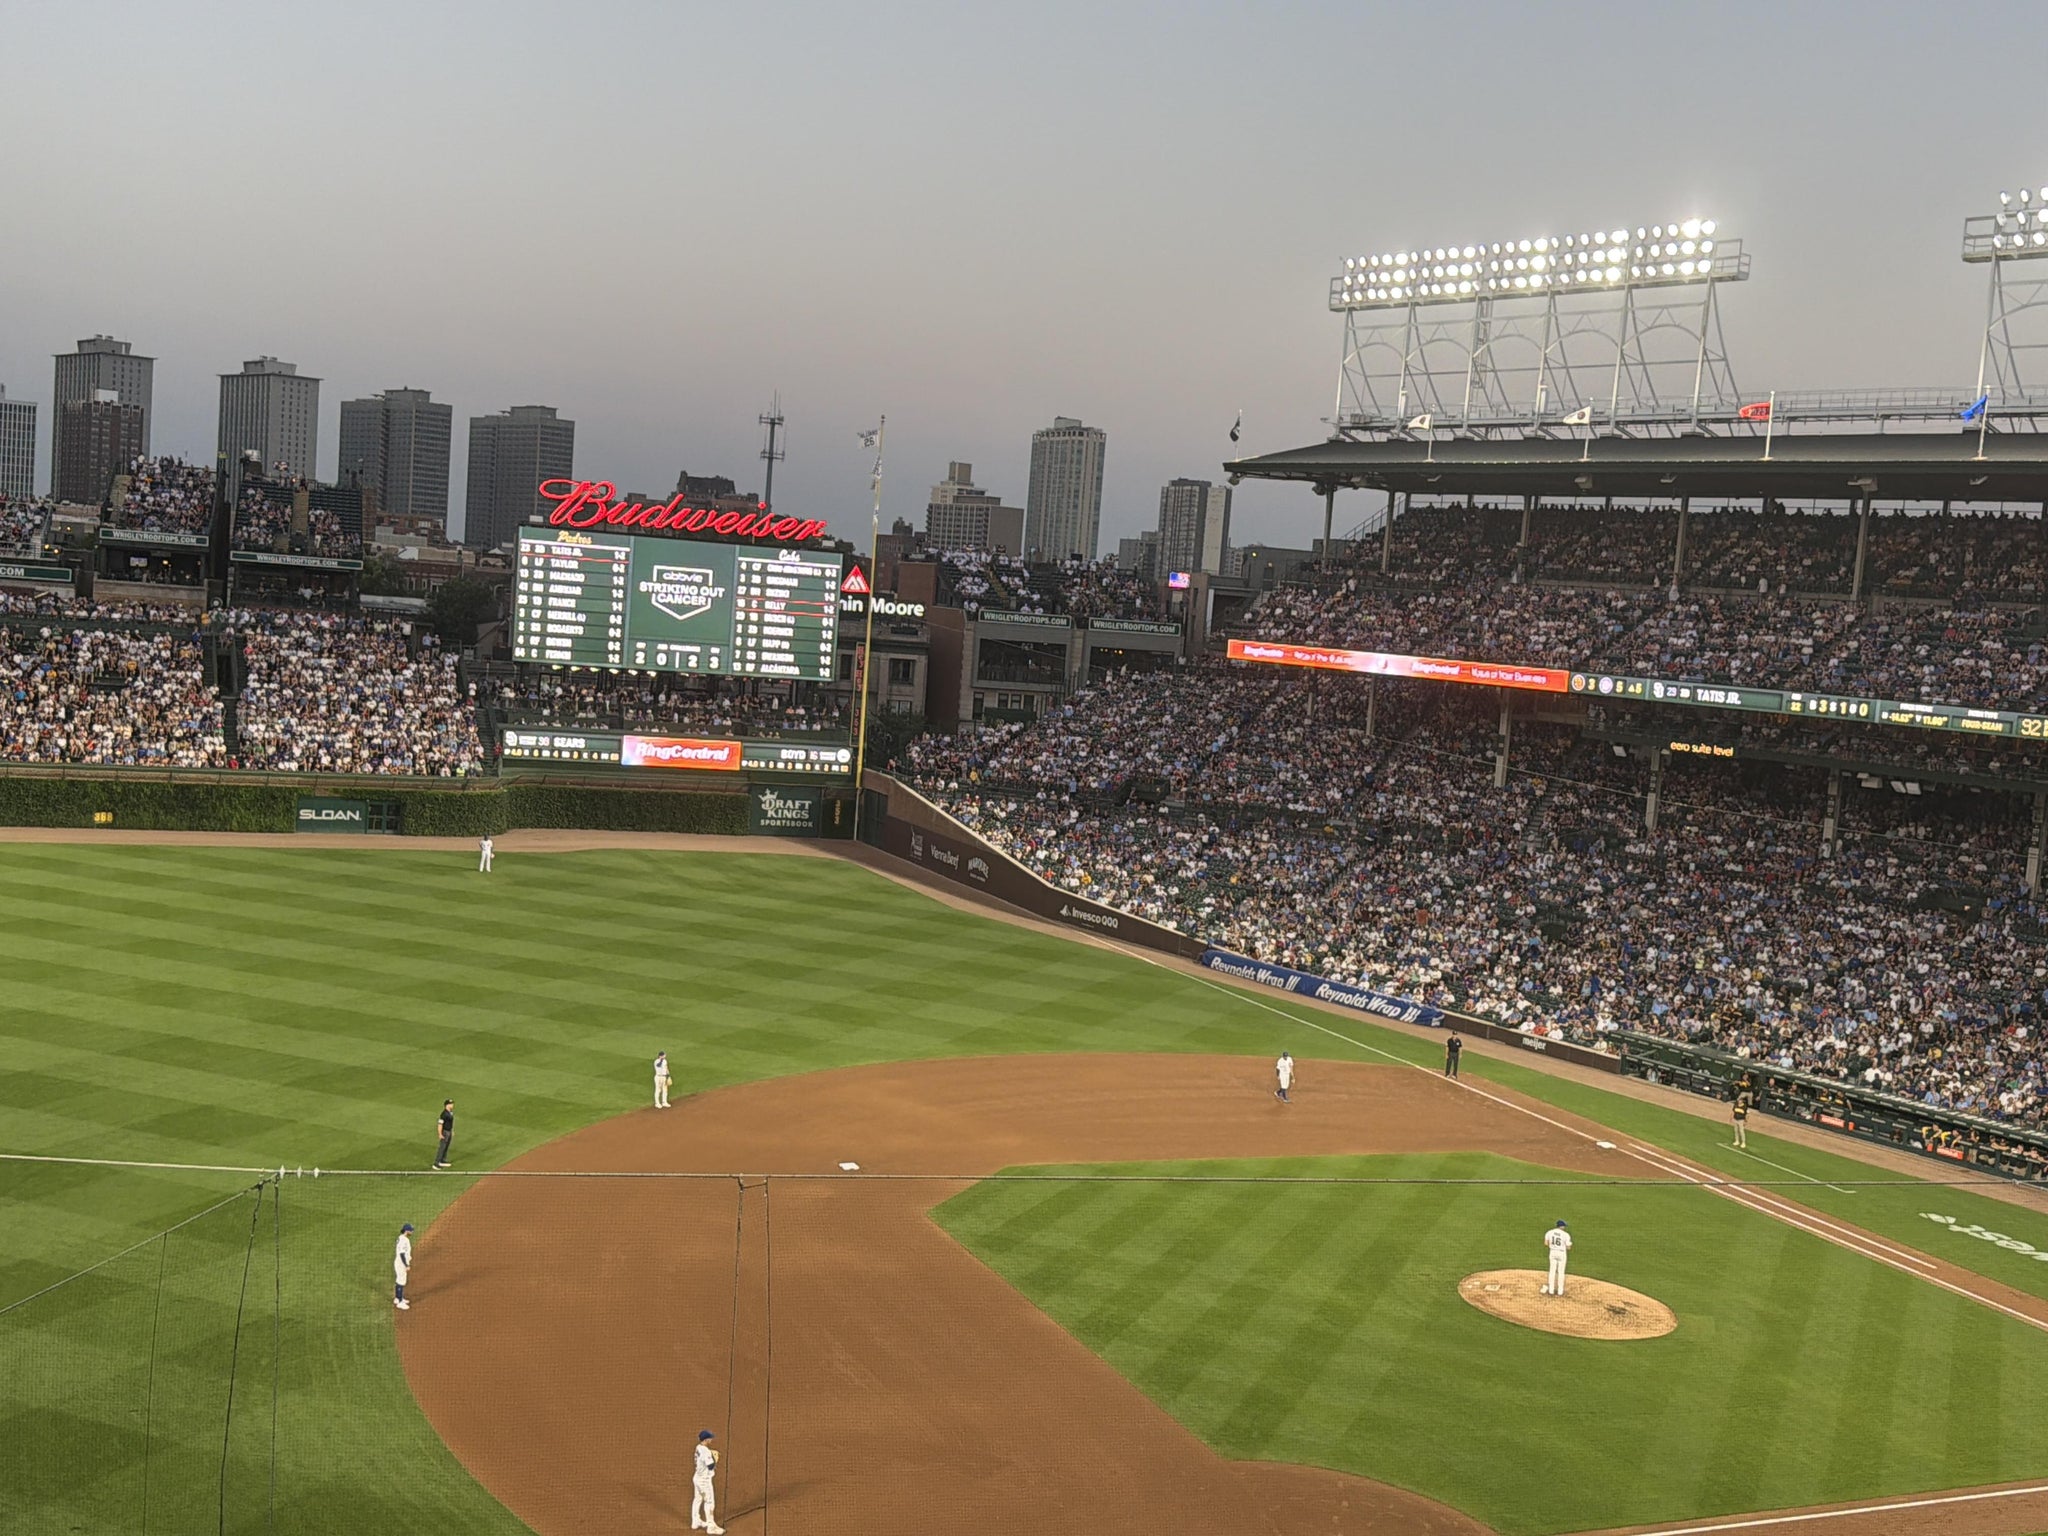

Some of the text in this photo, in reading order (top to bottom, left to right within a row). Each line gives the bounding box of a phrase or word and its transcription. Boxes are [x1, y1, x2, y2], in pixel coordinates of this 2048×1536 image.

[864, 436, 875, 448] 26
[539, 479, 827, 541] Budweiser
[557, 530, 592, 544] Padres
[779, 549, 800, 562] Cubs
[551, 558, 578, 569] TAYLOR
[549, 571, 585, 582] MACHADO
[662, 572, 703, 583] abbvie
[639, 581, 725, 598] STRIKING OUT
[657, 593, 707, 606] CANCER
[751, 600, 758, 608] C
[824, 605, 834, 614] 1-2
[870, 597, 925, 617] Moore
[983, 612, 1067, 626] WRIGLEYROOFTOPS.COM
[547, 623, 584, 635] BOGAERTS
[1093, 620, 1175, 633] WRIGLEYROOFTOPS.COM
[517, 635, 524, 644] 4
[762, 638, 780, 648] HAPP
[635, 651, 719, 669] 2 0 2 3
[1588, 678, 1642, 694] 3 5 5
[1697, 688, 1725, 703] TATIS
[1726, 692, 1741, 705] JR.
[1819, 699, 1828, 713] 3
[1840, 701, 1847, 715] 1
[1859, 703, 1868, 716] 0
[1961, 718, 2003, 732] FOUR-SEAM
[2021, 718, 2042, 736] 92
[554, 737, 585, 748] SEARS
[636, 742, 730, 761] RingCentral
[781, 749, 806, 760] BOYD
[1692, 743, 1712, 754] suite
[1713, 744, 1733, 756] level
[761, 798, 812, 810] DRAFT
[94, 812, 113, 822] 368
[767, 810, 810, 819] KINGS
[760, 819, 813, 828] SPORTSBOOK
[968, 857, 989, 879] MARQUEE
[1072, 906, 1118, 928] Invesco QQQ
[1210, 956, 1284, 988] Reynolds Wrap
[1315, 983, 1401, 1017] Reynolds Wrap
[1522, 1037, 1546, 1050] meijer
[1551, 1236, 1562, 1246] 16
